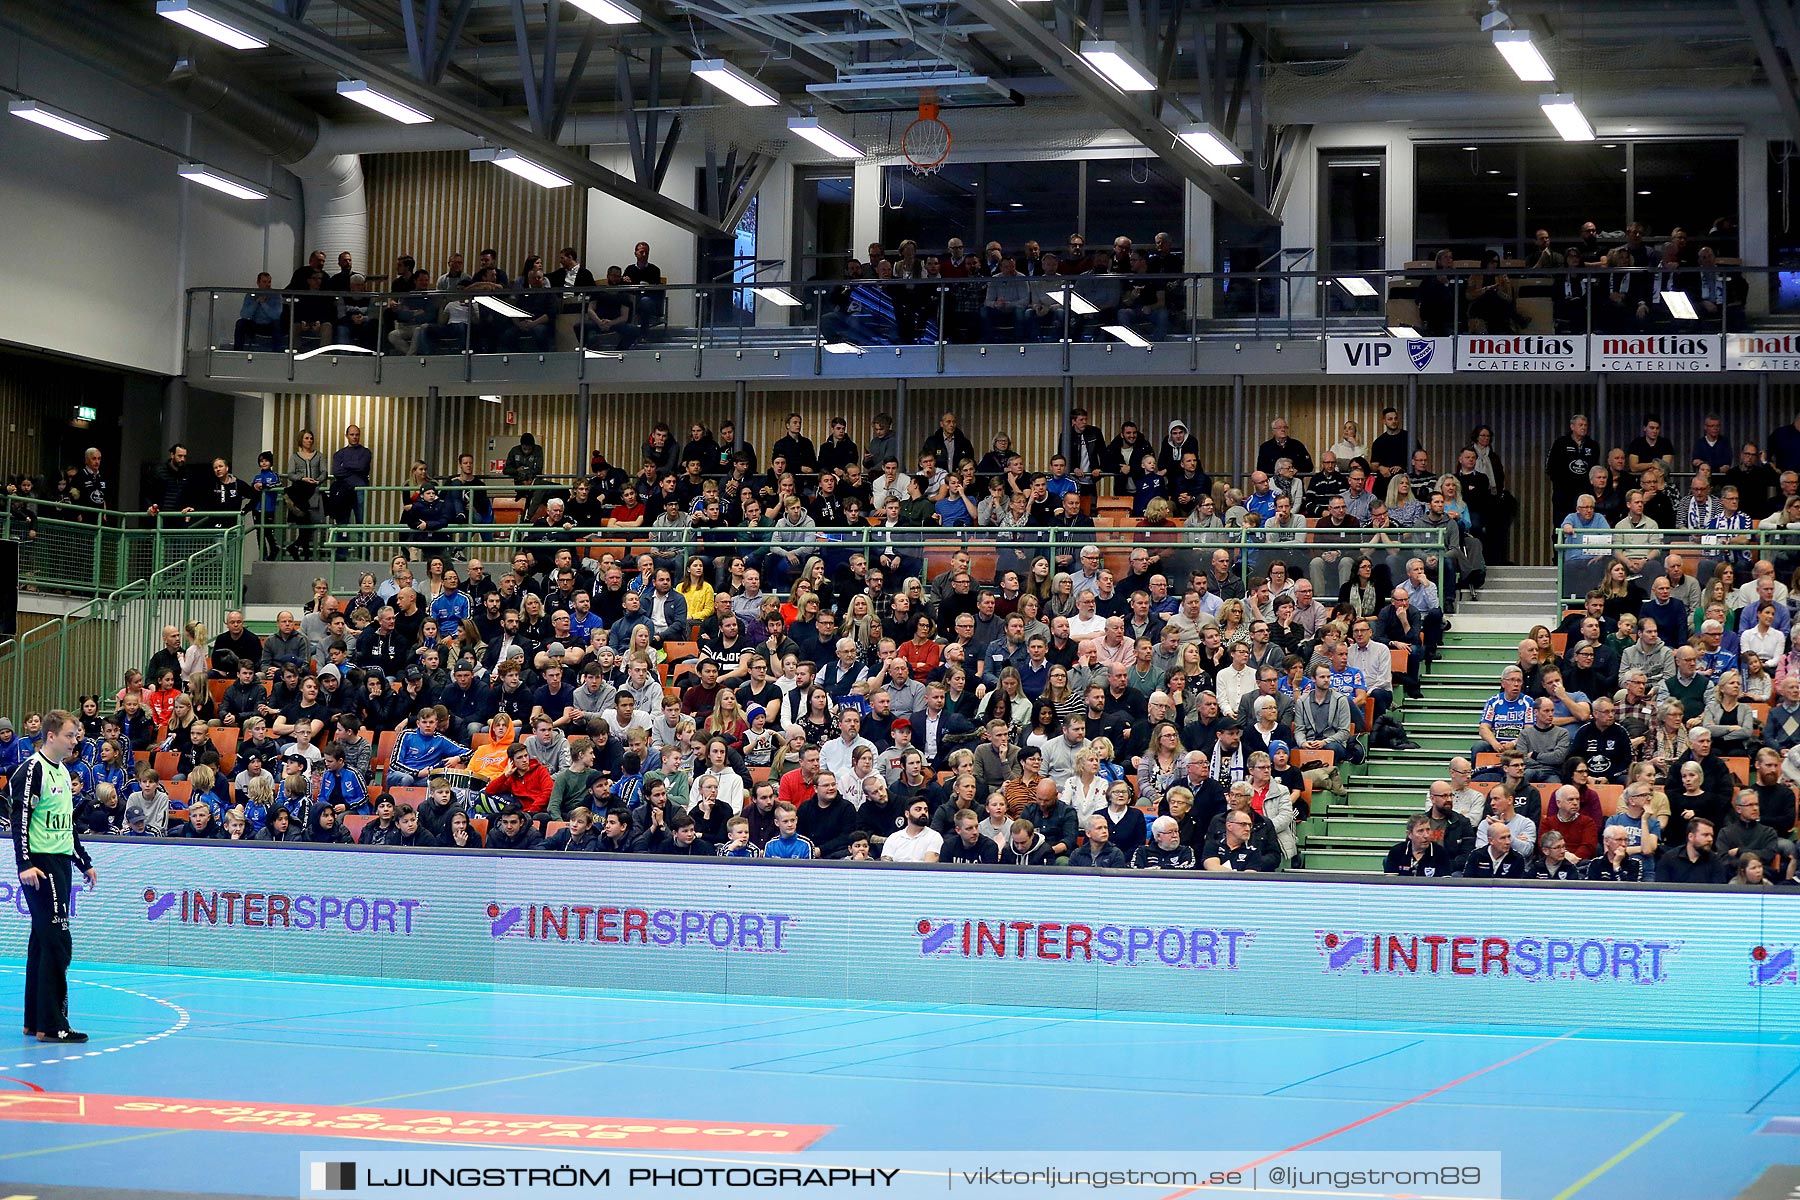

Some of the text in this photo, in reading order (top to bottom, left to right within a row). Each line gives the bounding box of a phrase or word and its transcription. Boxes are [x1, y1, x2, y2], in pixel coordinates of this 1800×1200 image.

[1344, 343, 1392, 366] VIP
[1469, 336, 1574, 354] mattias
[1603, 335, 1708, 354] mattias
[1478, 360, 1565, 370] CATERING
[1611, 360, 1700, 371] CATERING
[180, 890, 420, 934] INTERSPORT
[528, 905, 793, 949] INTERSPORT
[962, 921, 1246, 966] INTERSPORT
[1372, 935, 1671, 980] INTERSPORT
[113, 1102, 790, 1138] Ström & Andersson
[538, 1130, 630, 1140] AB
